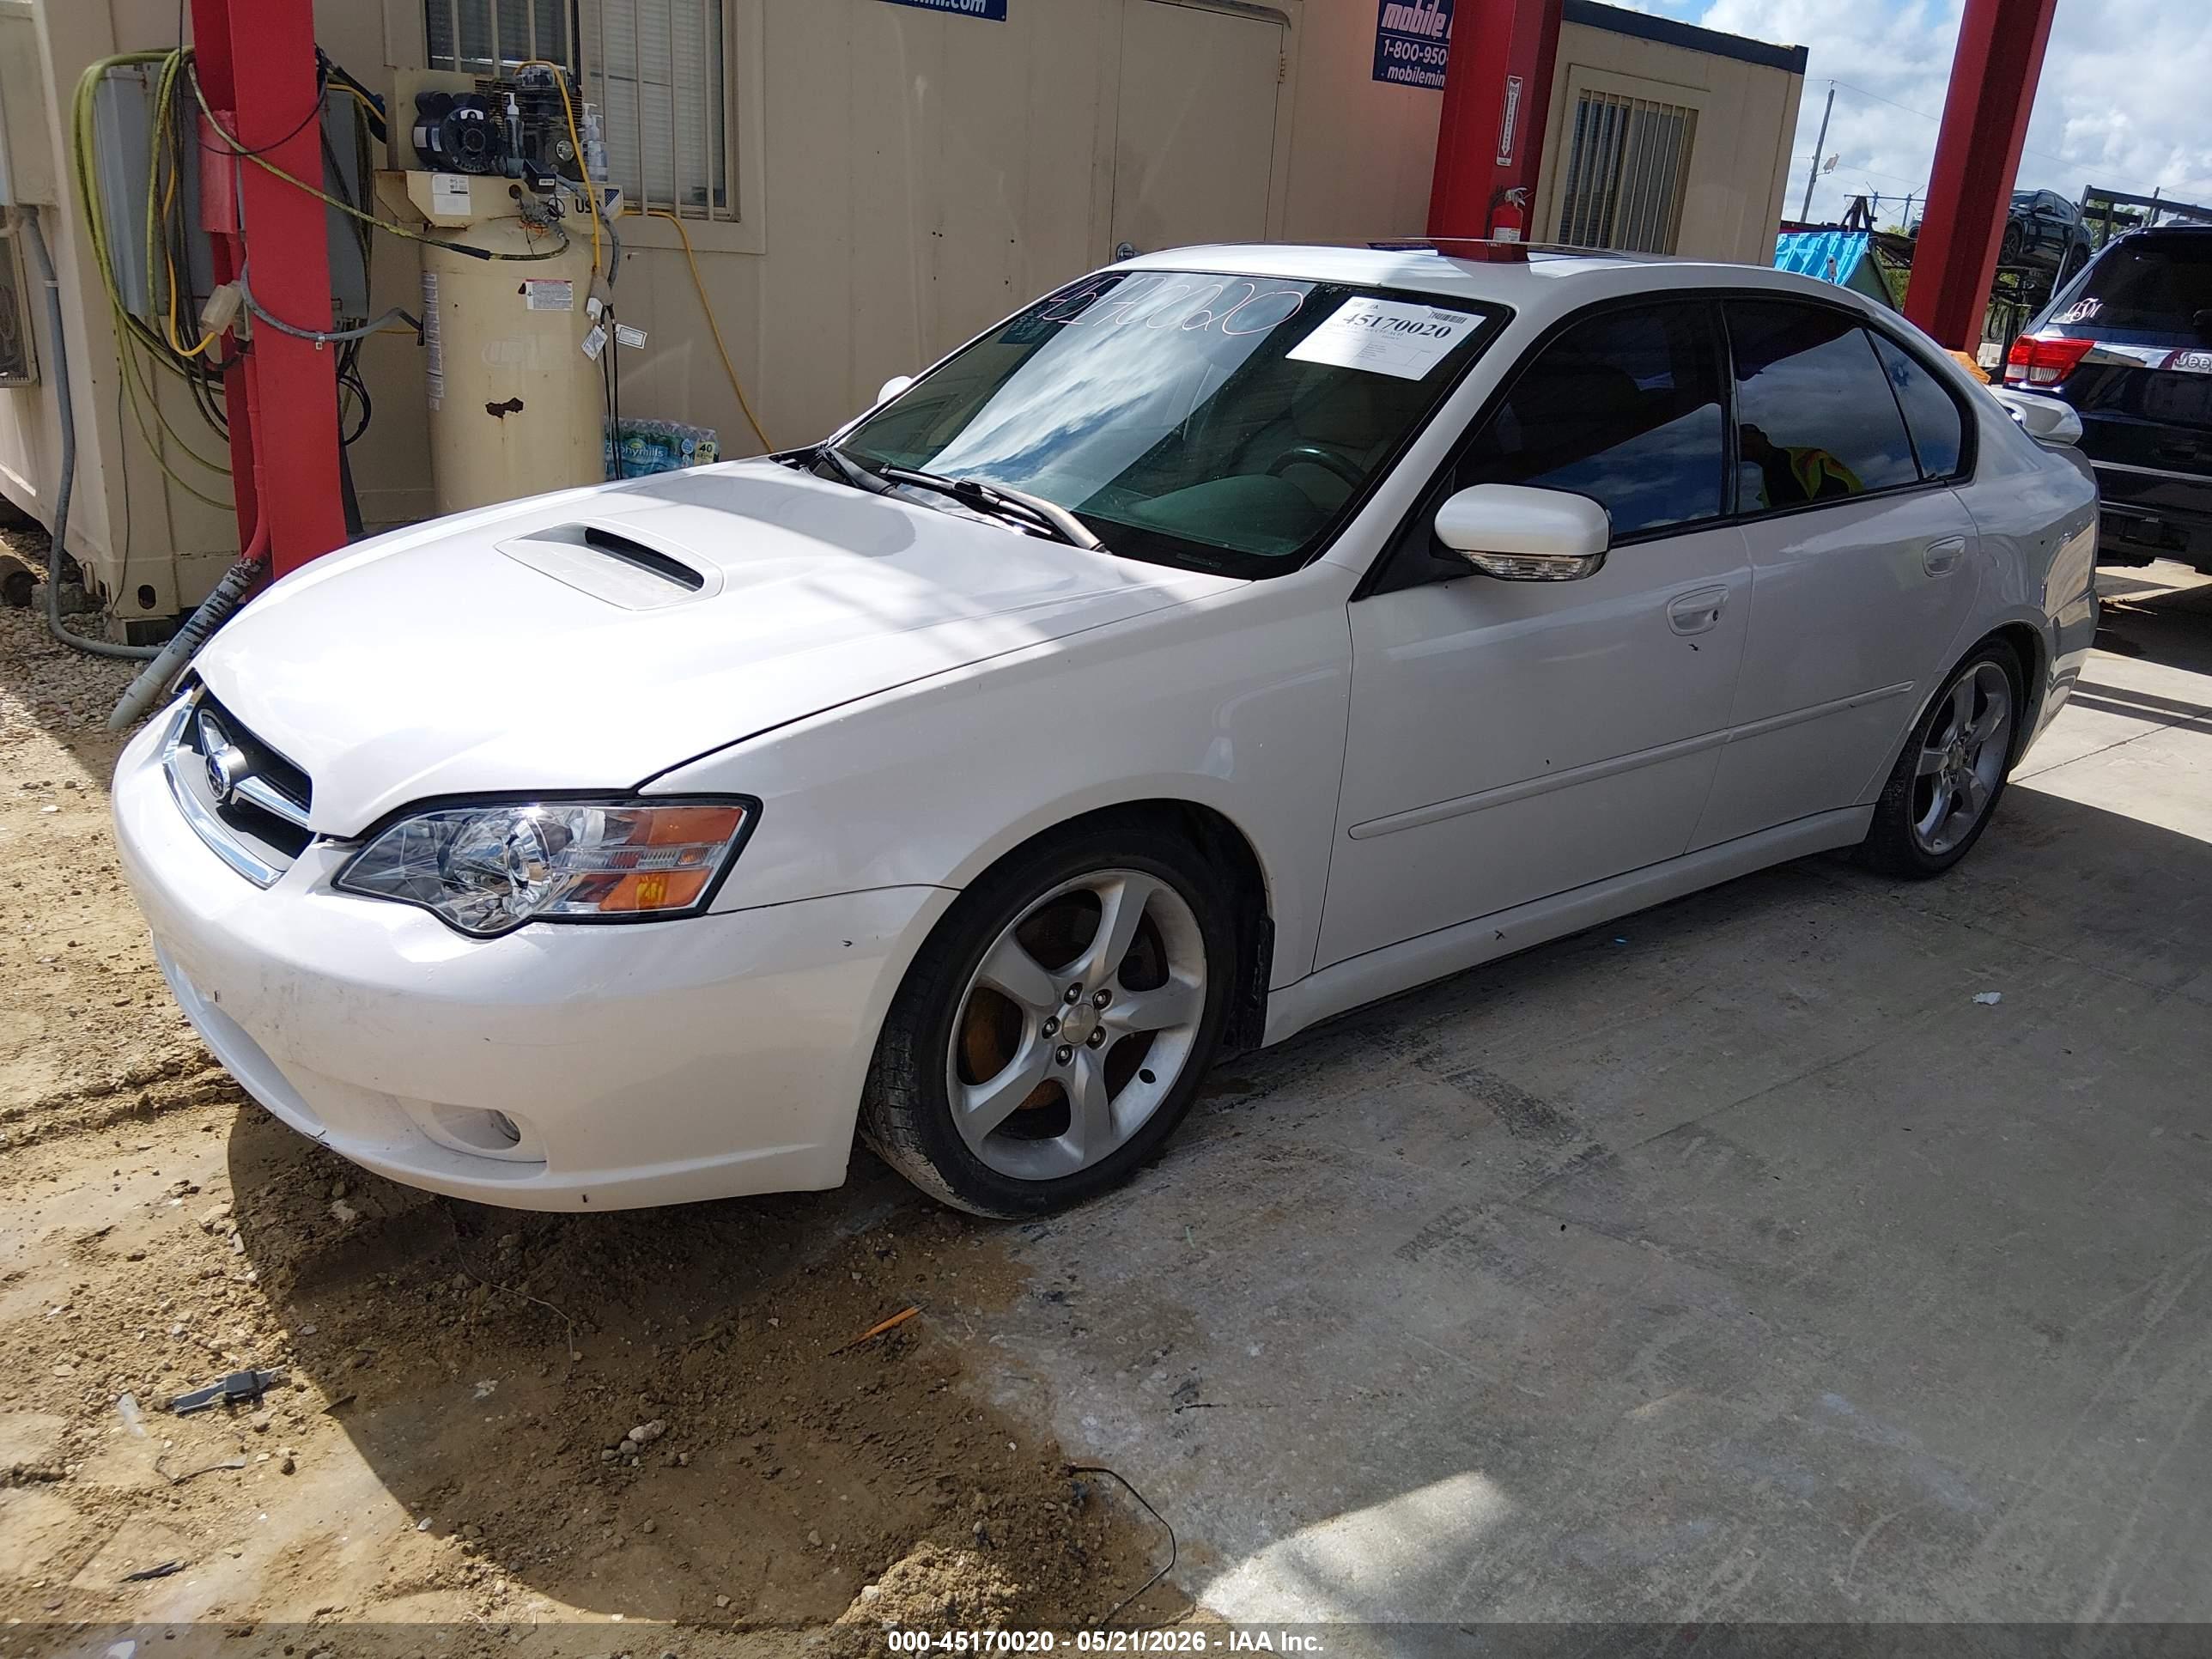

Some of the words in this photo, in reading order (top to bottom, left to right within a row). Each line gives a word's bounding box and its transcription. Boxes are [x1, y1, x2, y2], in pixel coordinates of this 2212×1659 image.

[1381, 0, 1447, 37] mobile
[1383, 39, 1449, 66] 1-800-950
[1343, 313, 1452, 339] 45170020
[699, 443, 713, 453] 40
